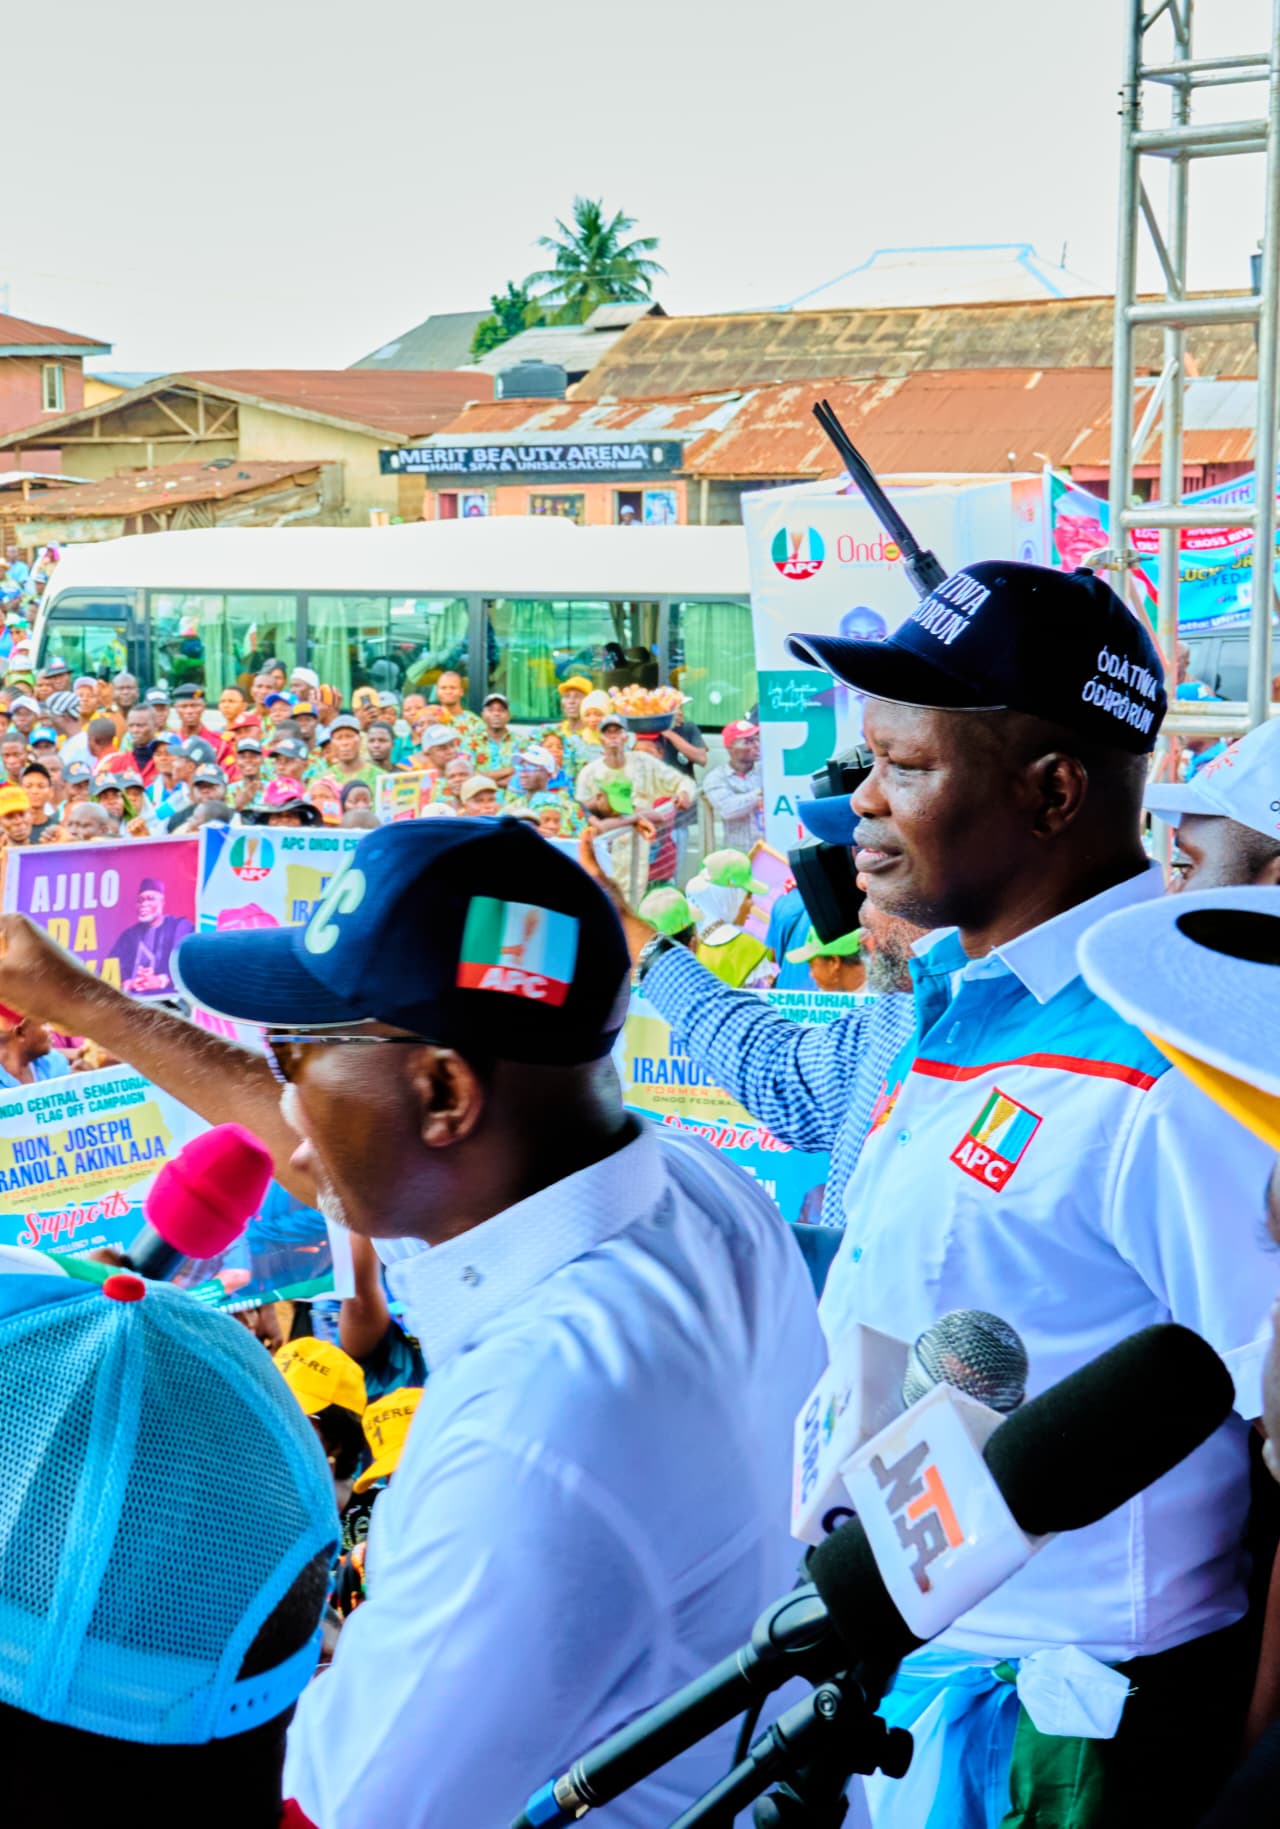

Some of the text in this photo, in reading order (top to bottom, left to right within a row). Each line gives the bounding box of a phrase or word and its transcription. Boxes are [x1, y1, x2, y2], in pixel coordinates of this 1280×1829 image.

[398, 444, 649, 465] MERIT BEAUTY ARENA
[470, 462, 496, 472] SPA
[1186, 535, 1227, 549] CROSS
[782, 561, 820, 576] APC
[281, 836, 305, 851] APC
[308, 837, 340, 851] ONDO
[29, 869, 120, 914] AJILO
[477, 966, 549, 999] APC
[768, 992, 857, 1009] SENATORIAL
[779, 1009, 842, 1025] AMPAIGN
[27, 1092, 80, 1114] CENTRAL
[83, 1075, 153, 1101] SENATORIA
[645, 1084, 711, 1098] FORMER
[36, 1091, 146, 1125] FLAG OFF CAMPAIGN
[11, 1117, 133, 1165] HON. JOSEPH
[75, 1135, 167, 1175] AKINLAJA
[955, 1140, 1008, 1183] APC
[3, 1184, 57, 1201] FORMER
[16, 1190, 132, 1249] Supports
[870, 1440, 966, 1594] NTA
